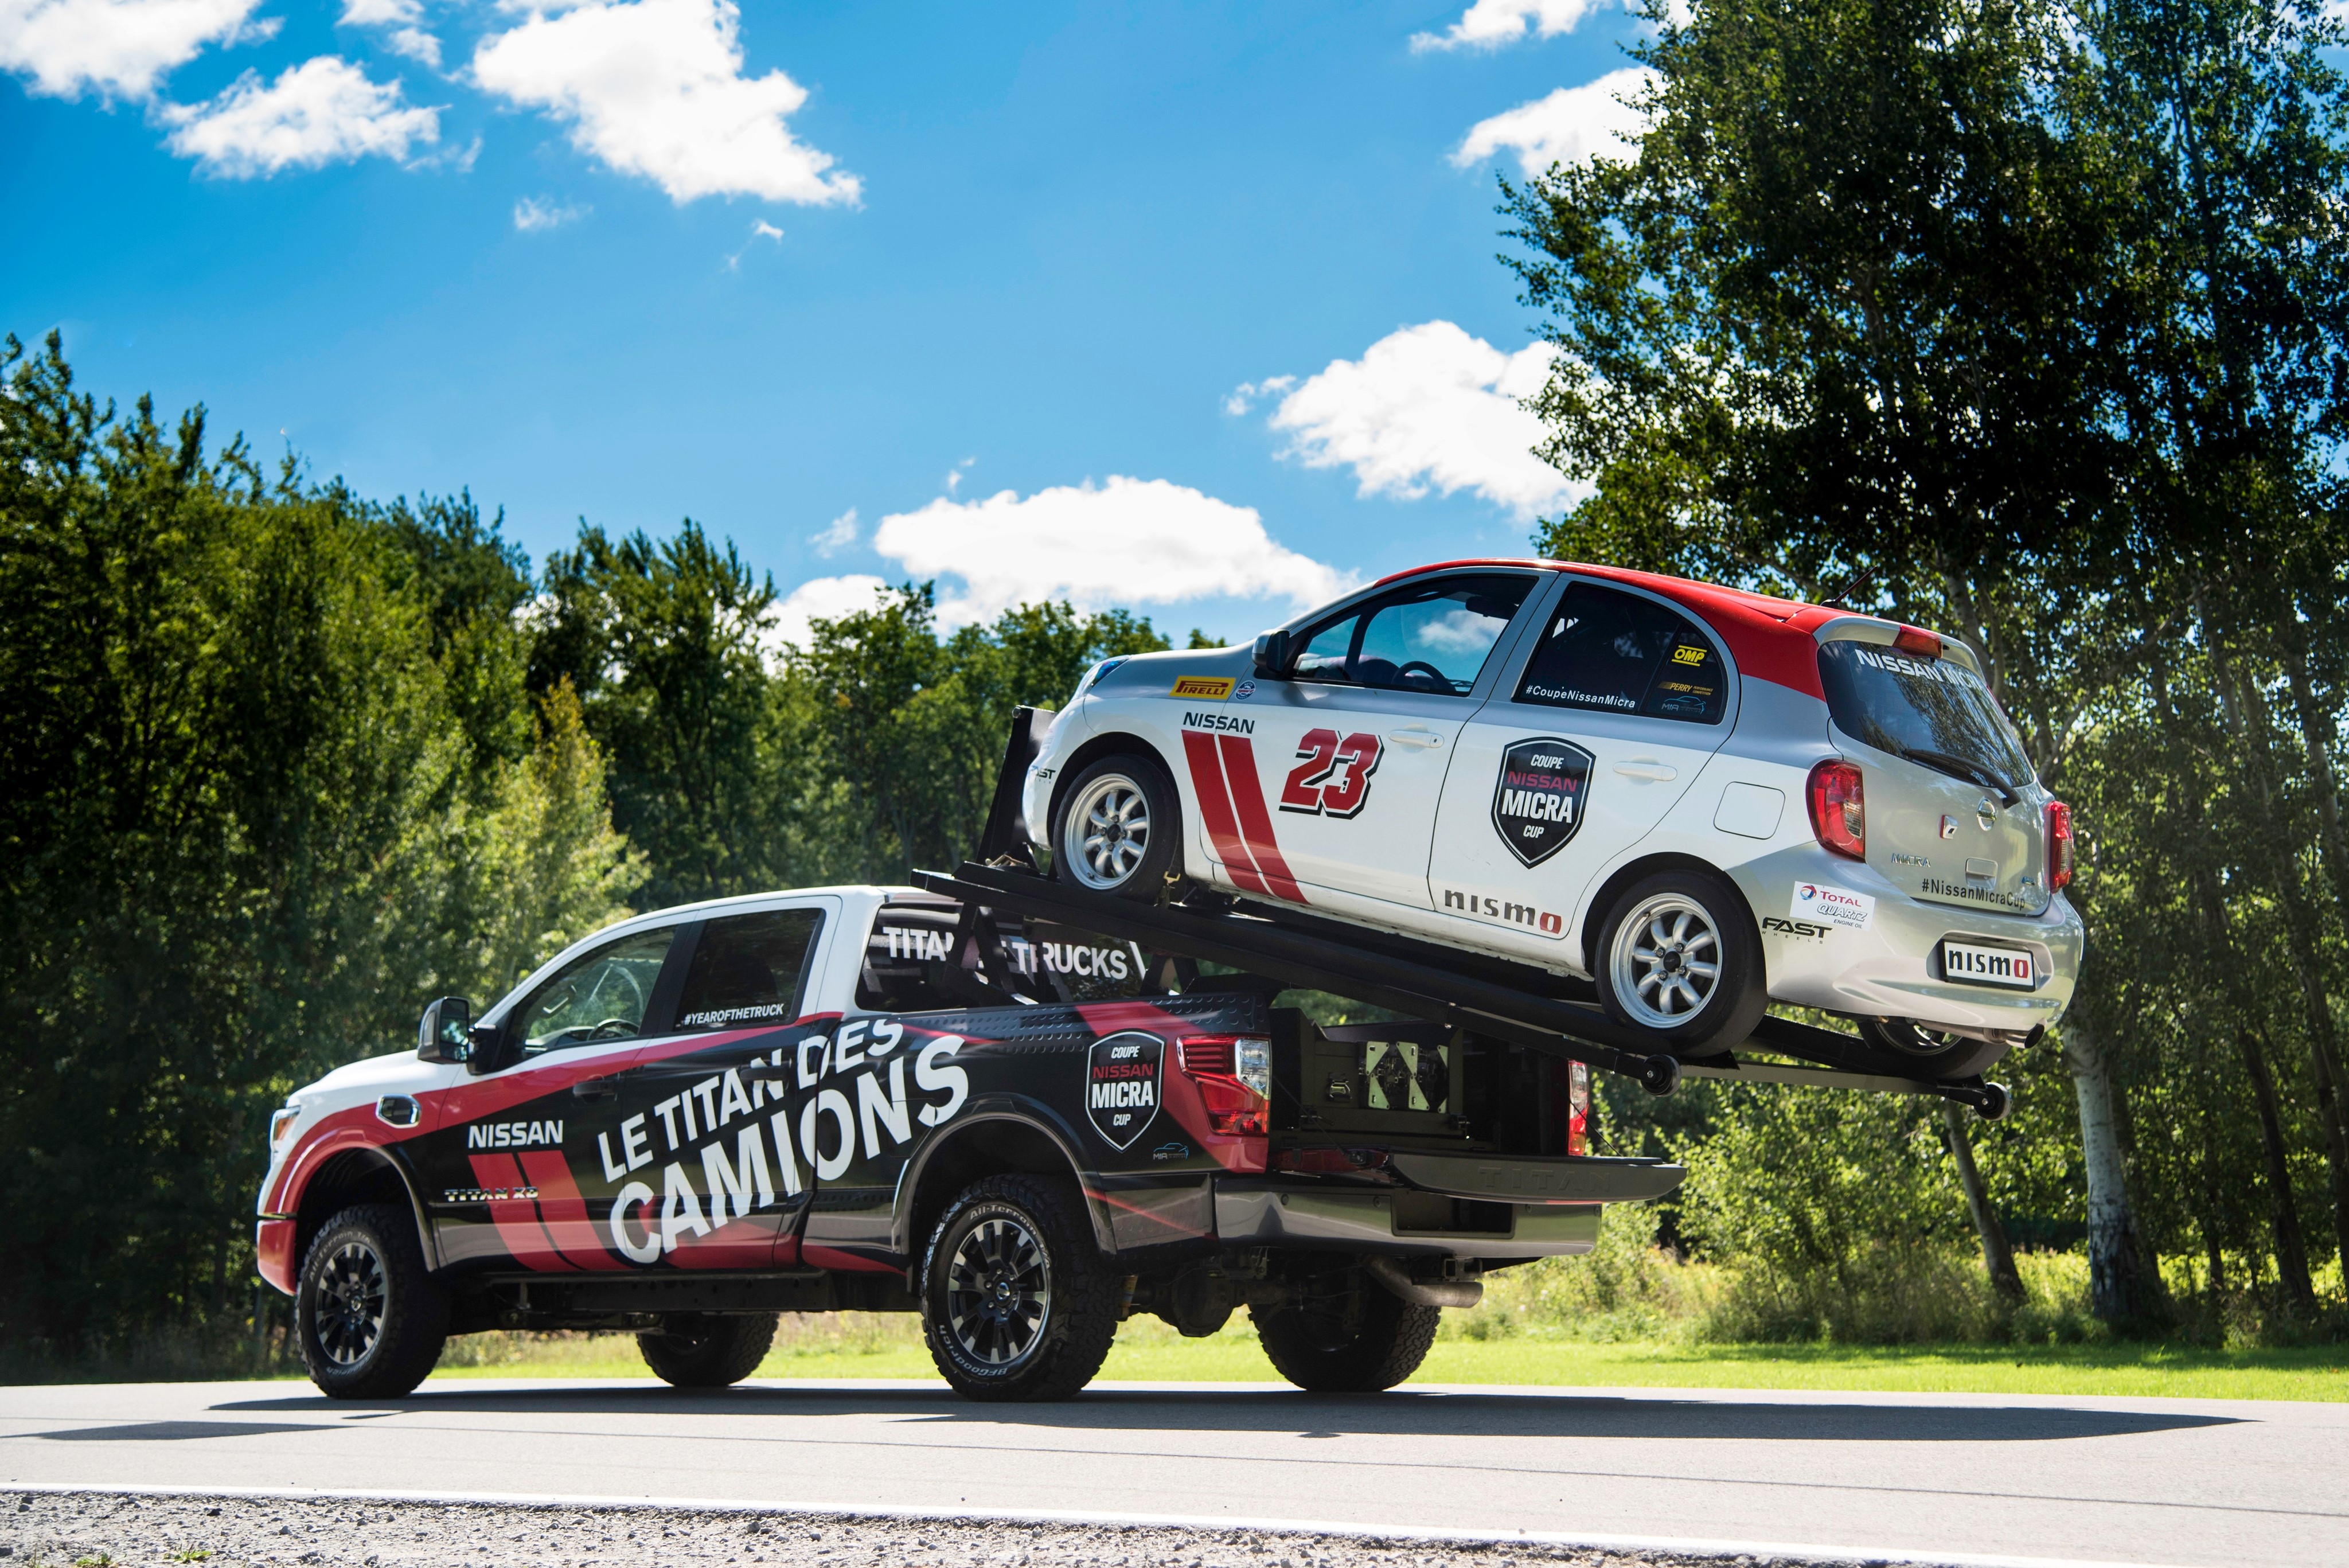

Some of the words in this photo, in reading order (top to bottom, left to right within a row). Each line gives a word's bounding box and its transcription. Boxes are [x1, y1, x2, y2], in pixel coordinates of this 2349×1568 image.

[1675, 649, 1705, 663] OMP
[1855, 649, 1944, 682] NISSAN
[1176, 680, 1230, 696] PIRELLI
[1525, 685, 1636, 708] #CoupeNissanMicra
[1669, 682, 1693, 693] PERRY
[1183, 711, 1255, 735] NISSAN
[1531, 754, 1564, 770] COUPE
[1278, 728, 1385, 820] 23
[1507, 771, 1578, 793] NISSAN
[1501, 789, 1573, 824] MICRA
[1523, 825, 1545, 838] CUP
[1891, 852, 1931, 868] MICRA
[1820, 891, 1862, 907] TOTAL
[1922, 878, 2026, 911] #NissanMicraCup
[1445, 889, 1562, 935] nismo
[1817, 903, 1868, 922] QUARTZ
[1833, 919, 1854, 927] ENGINE
[1761, 930, 1824, 945] WHEELS
[1762, 916, 1833, 939] FAST
[1012, 941, 1127, 980] TRUCKS
[1949, 950, 2029, 979] nismo
[685, 1003, 785, 1025] #YEAROFTHETRUCK
[1111, 1046, 1140, 1059] COUPE
[1092, 1063, 1154, 1079] NISSAN
[598, 1112, 653, 1183] LE
[654, 1048, 785, 1152] TITAN
[798, 1019, 903, 1090] DES
[1091, 1081, 1154, 1109] MICRA
[1113, 1114, 1131, 1126] CUP
[468, 1119, 564, 1149] NISSAN
[610, 1035, 969, 1263] CAMIONS
[444, 1187, 508, 1202] TITAN
[513, 1186, 539, 1199] XD
[970, 1204, 1037, 1235] All-Terrain
[939, 1324, 1008, 1376] BFGoodrich
